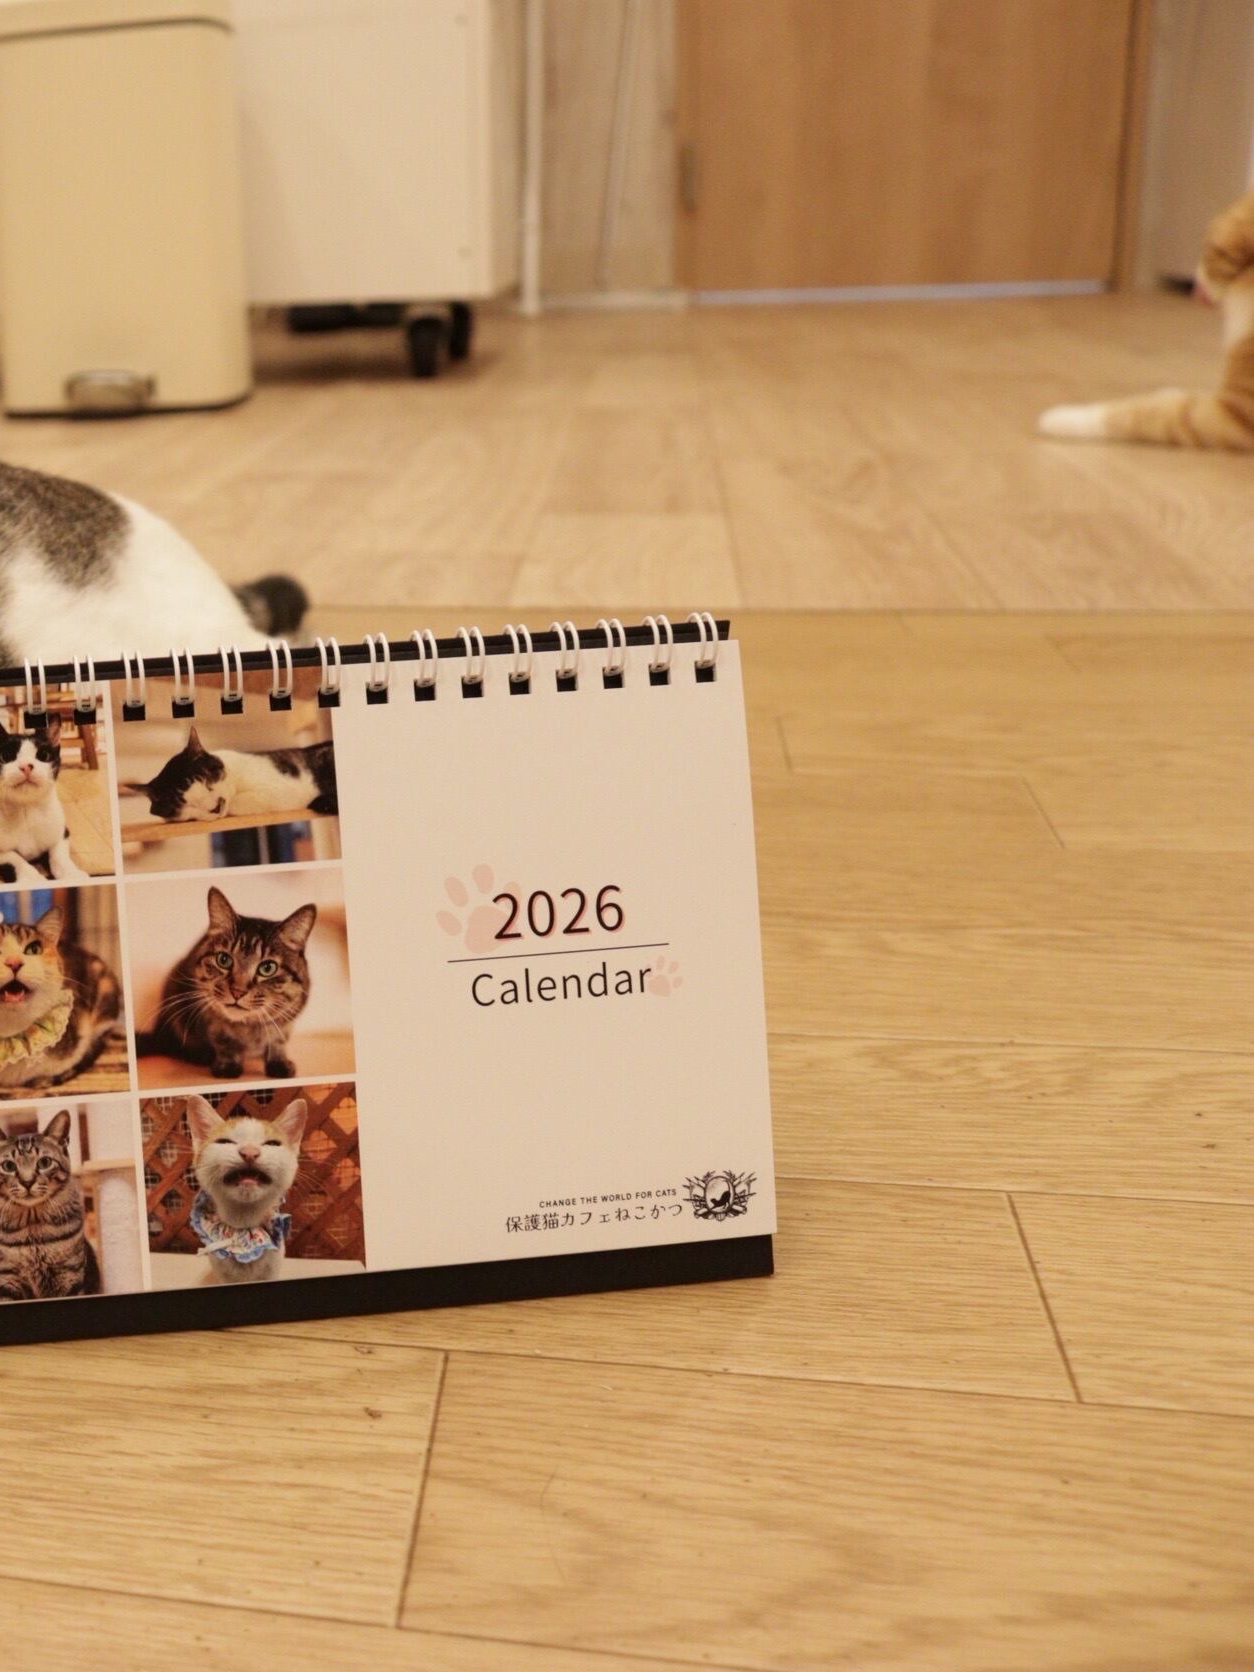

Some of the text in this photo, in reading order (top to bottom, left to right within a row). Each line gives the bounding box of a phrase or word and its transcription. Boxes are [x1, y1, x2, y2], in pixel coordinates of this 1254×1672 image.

[492, 884, 625, 940] 2026
[471, 961, 652, 1007] Calendar
[539, 1188, 677, 1208] CHANGE THE WORLD FOR CATS
[505, 1203, 683, 1233] 保護猫カフェねこかつ
